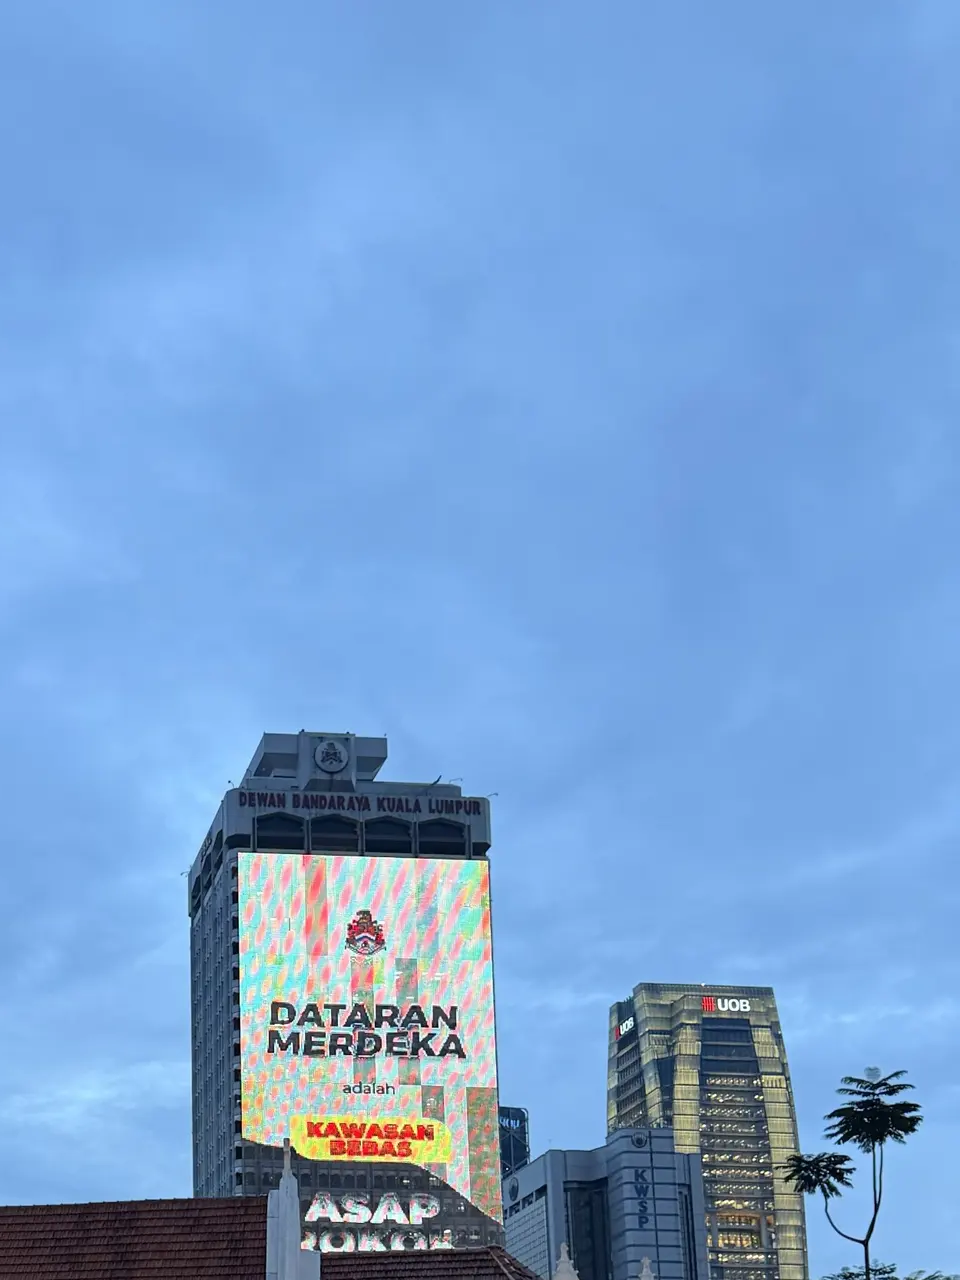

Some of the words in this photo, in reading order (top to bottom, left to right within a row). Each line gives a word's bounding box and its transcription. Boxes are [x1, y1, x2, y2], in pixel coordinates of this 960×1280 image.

[239, 791, 286, 809] DEWAN
[292, 793, 371, 812] BANDARAYA
[376, 797, 422, 813] KUALA
[428, 798, 481, 815] LUMPUR
[270, 1001, 458, 1030] DATARAN
[718, 998, 751, 1012] UOB
[619, 1017, 635, 1035] UOB
[267, 1029, 467, 1059] MERDEKA
[342, 1081, 396, 1096] adalah
[306, 1121, 435, 1141] KAWASAN
[329, 1139, 413, 1157] BEBAS
[304, 1191, 441, 1225] ASAP
[634, 1168, 649, 1228] KWSP
